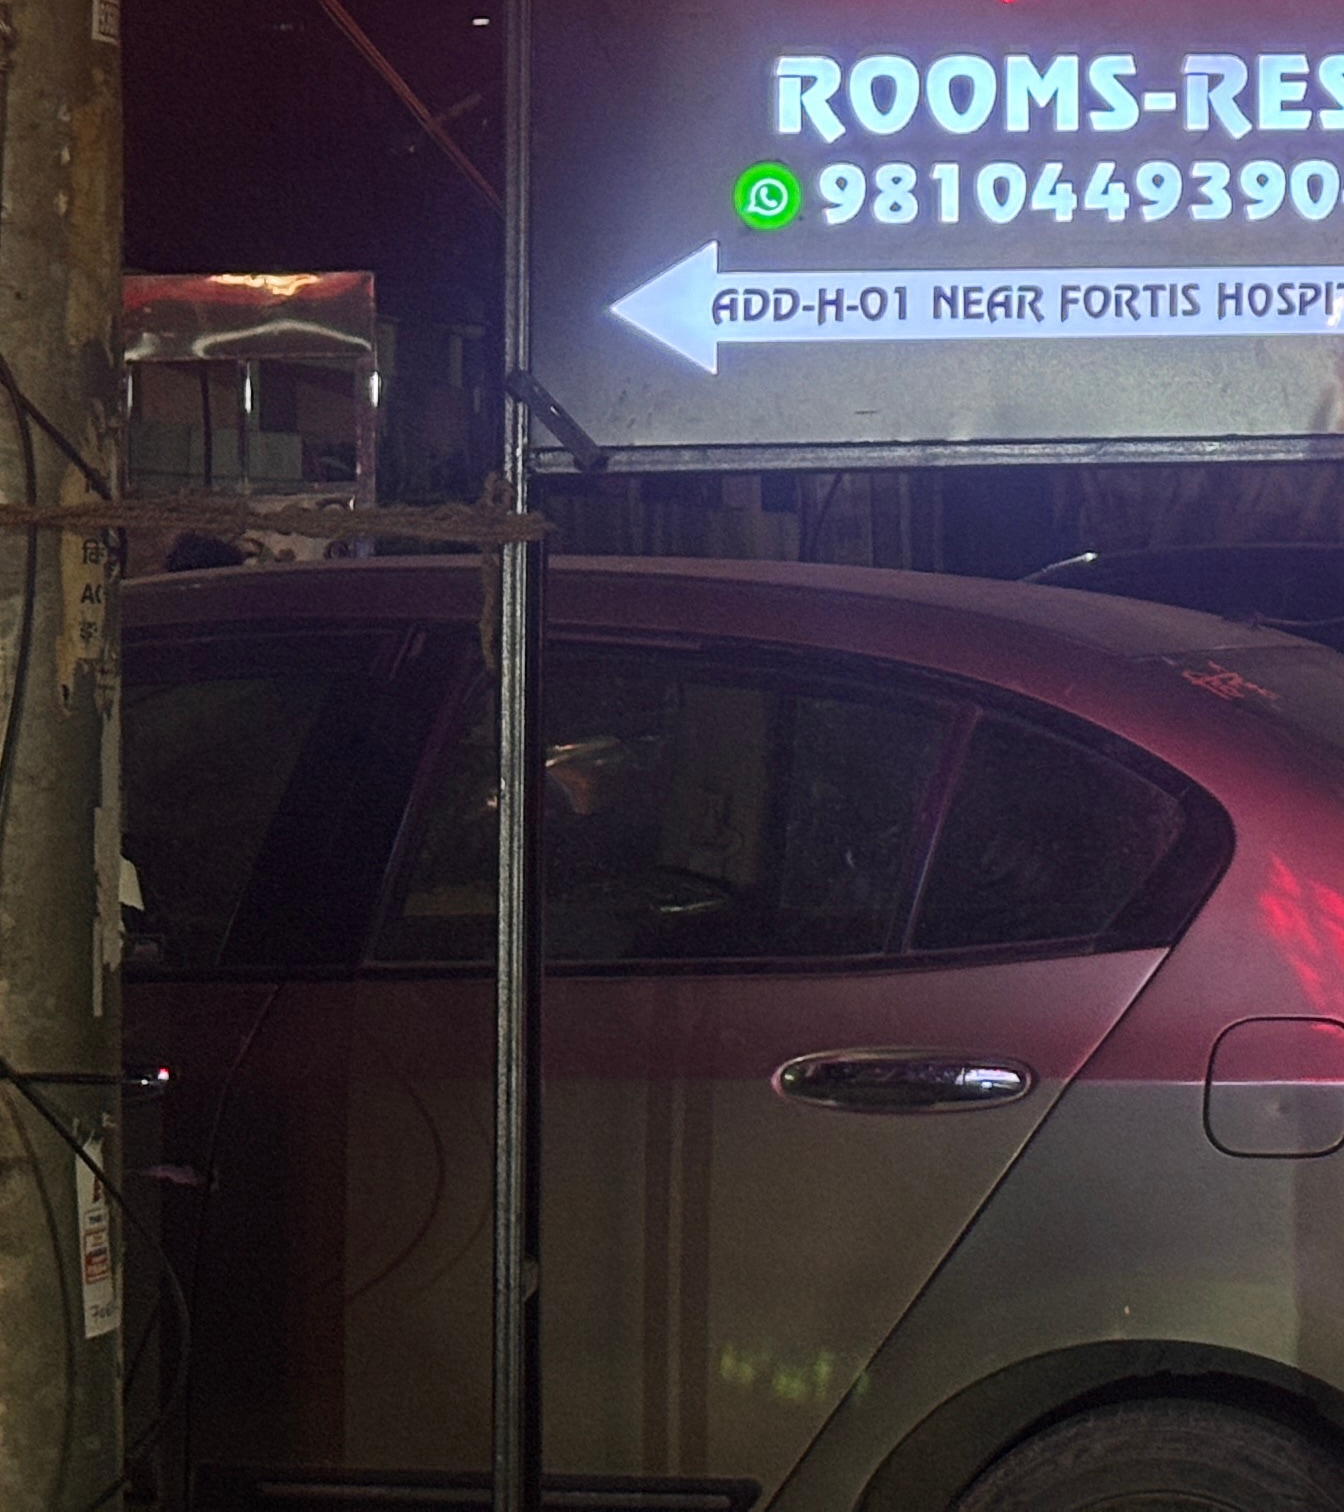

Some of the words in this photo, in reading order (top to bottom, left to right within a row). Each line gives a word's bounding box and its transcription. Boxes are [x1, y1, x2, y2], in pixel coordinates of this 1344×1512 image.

[711, 286, 908, 325] ADD-H-01
[933, 285, 1044, 324] NEAR
[1060, 283, 1200, 322] FORTIS
